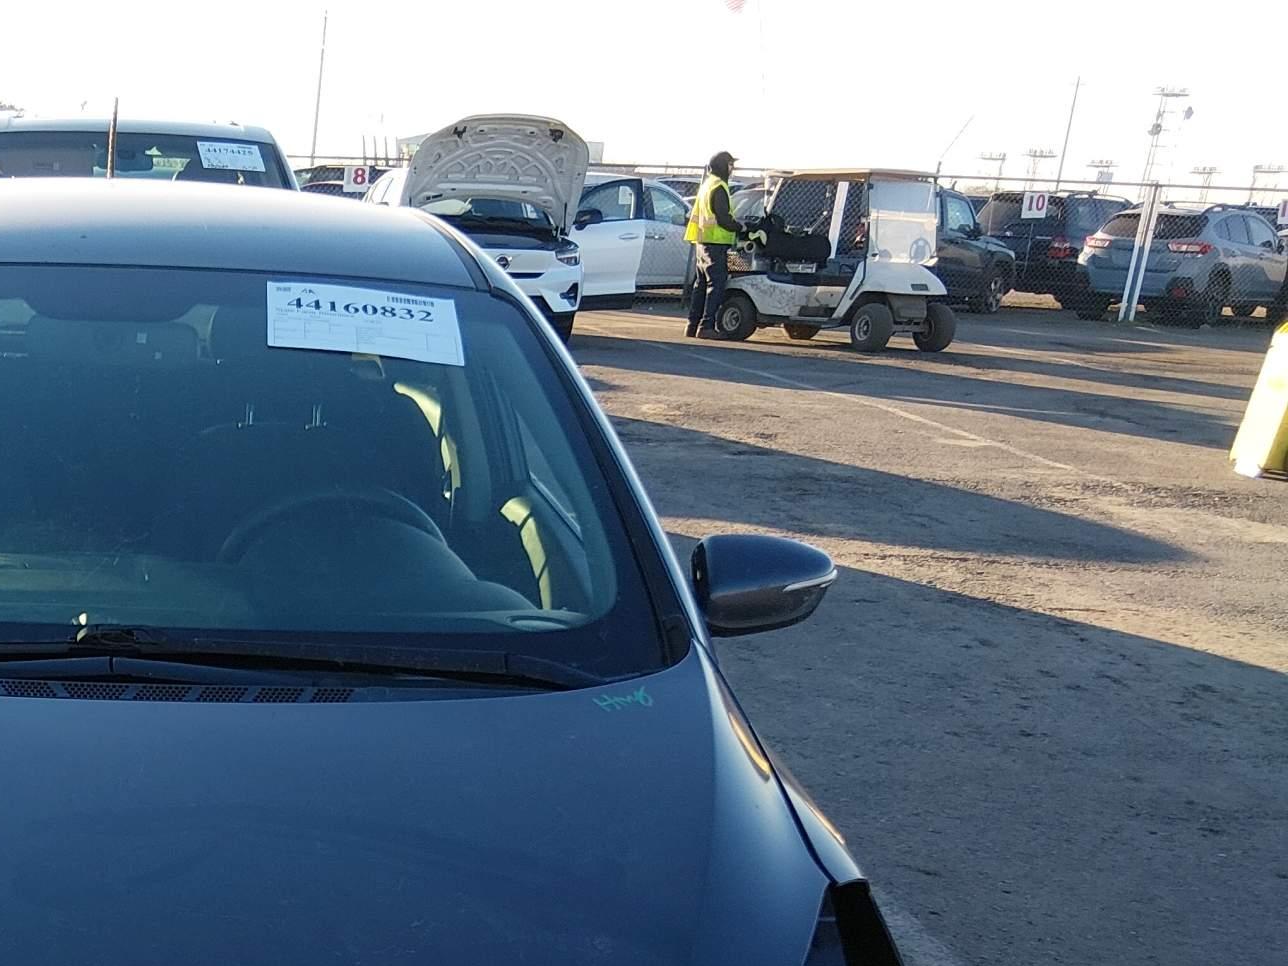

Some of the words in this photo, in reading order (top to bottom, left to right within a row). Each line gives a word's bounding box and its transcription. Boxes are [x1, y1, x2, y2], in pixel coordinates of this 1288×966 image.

[353, 167, 366, 185] 8
[1027, 194, 1046, 211] 10
[287, 297, 434, 323] 44160832
